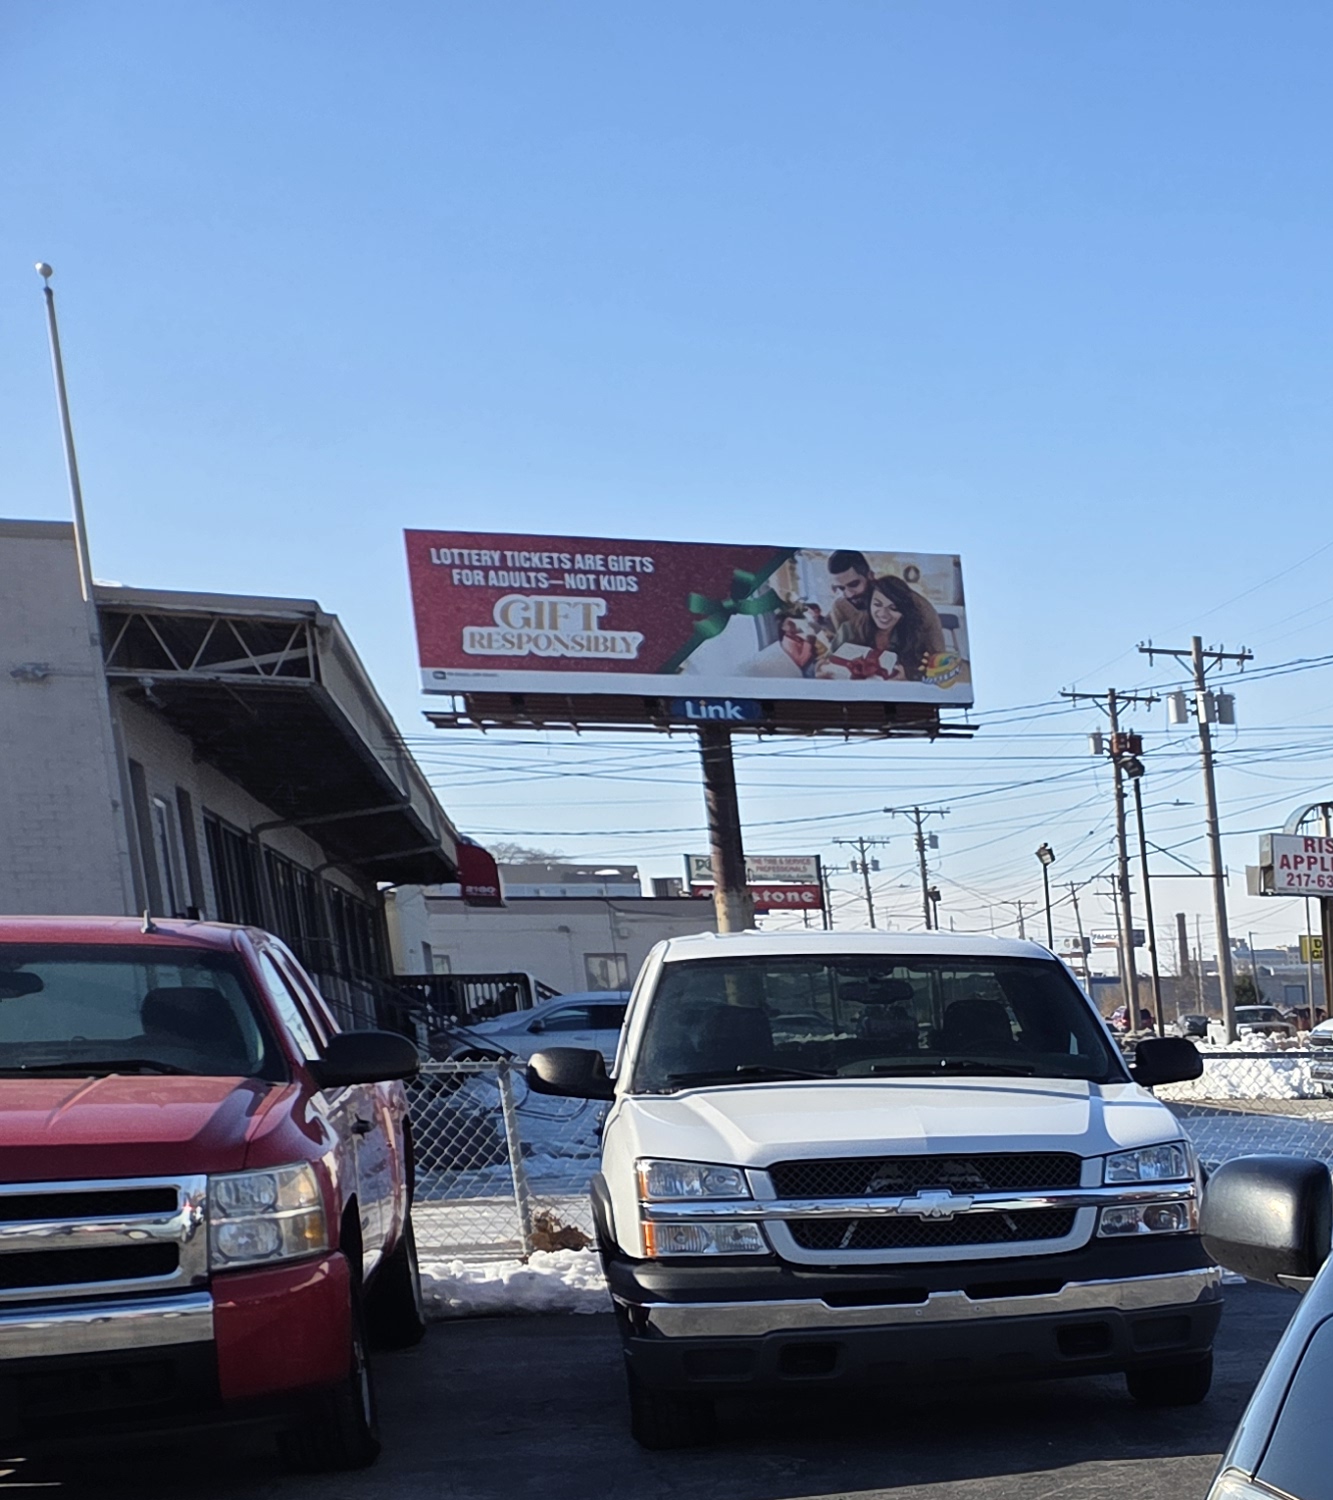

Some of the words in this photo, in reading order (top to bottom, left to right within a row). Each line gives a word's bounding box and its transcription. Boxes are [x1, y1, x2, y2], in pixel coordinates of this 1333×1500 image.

[430, 548, 501, 566] LOTTERY
[504, 550, 572, 570] TICKETS
[574, 553, 605, 571] ARE
[607, 556, 655, 573] GIFTS
[452, 569, 486, 586] FOR
[599, 575, 639, 592] KIDS
[499, 599, 601, 631] GIFT
[469, 631, 634, 653] RESPONSIBLY
[685, 700, 746, 720] Link
